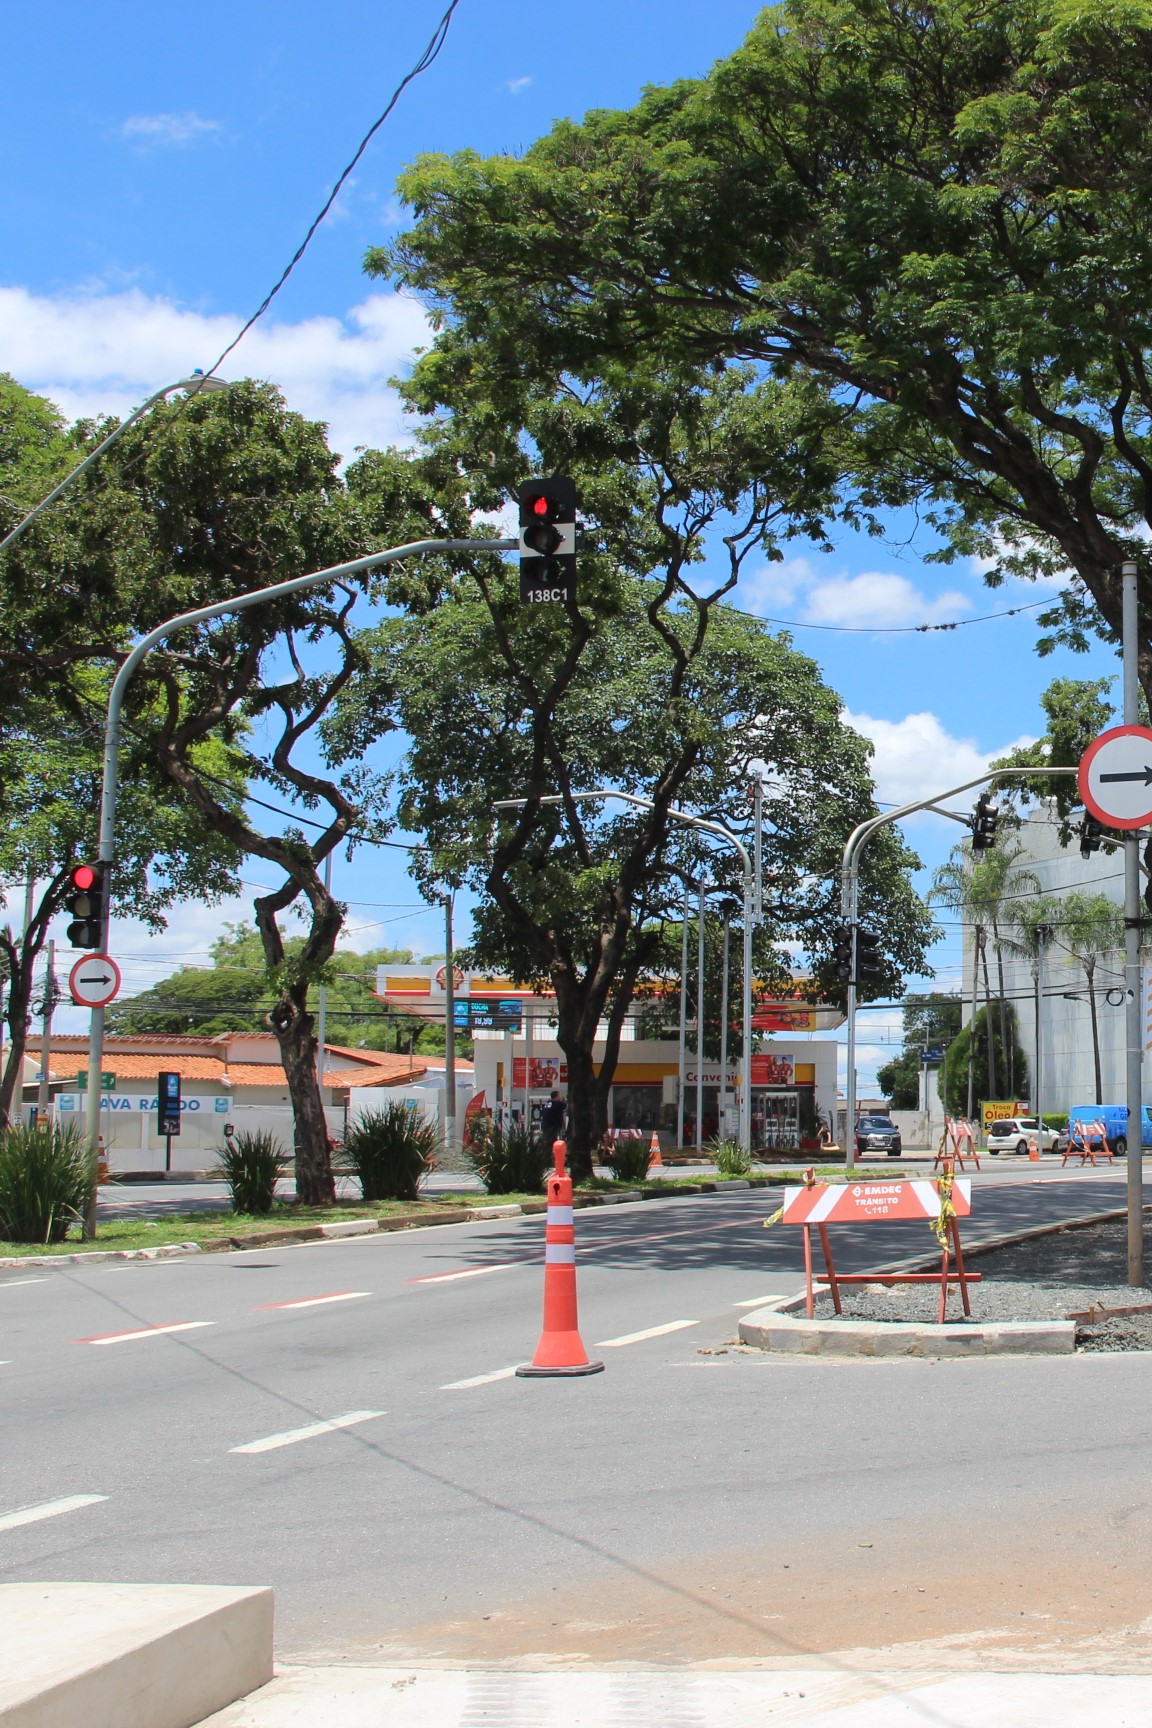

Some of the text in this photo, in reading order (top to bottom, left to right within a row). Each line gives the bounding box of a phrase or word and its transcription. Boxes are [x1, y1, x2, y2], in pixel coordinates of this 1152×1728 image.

[527, 588, 568, 603] 138C1
[139, 1096, 200, 1111] RÁDO
[865, 1186, 901, 1195] EMDEC
[872, 1206, 889, 1214] 118
